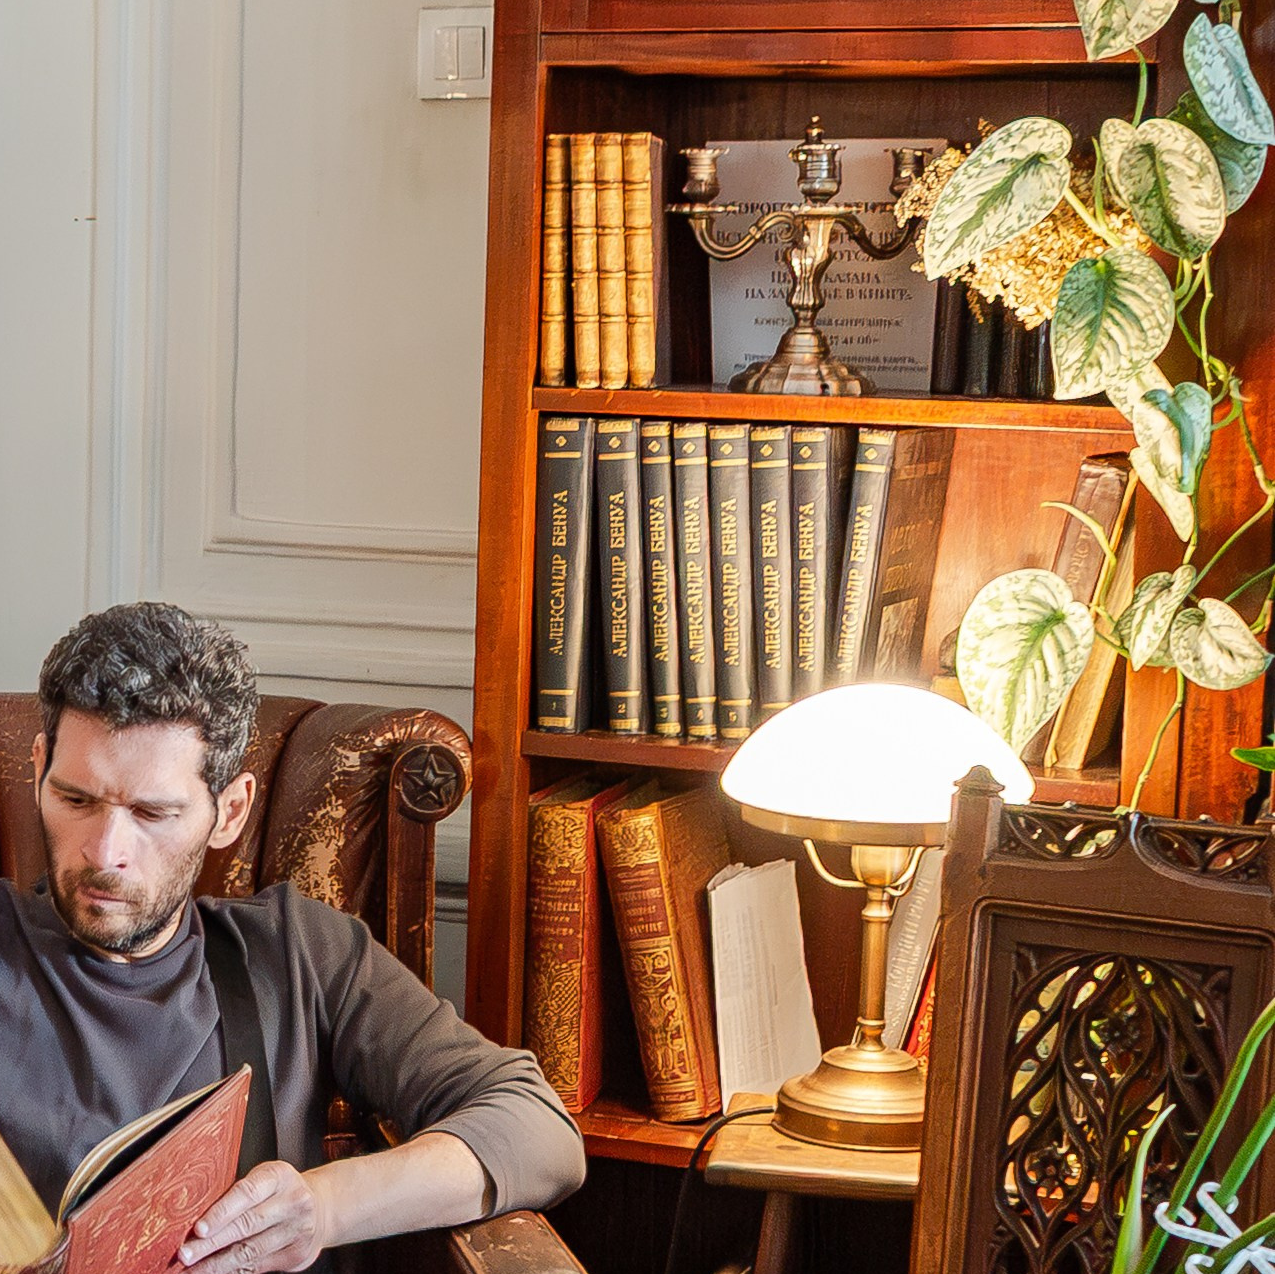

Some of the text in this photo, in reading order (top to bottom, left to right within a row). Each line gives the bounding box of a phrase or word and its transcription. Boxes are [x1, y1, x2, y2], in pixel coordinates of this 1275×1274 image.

[549, 490, 569, 656] АЛЕКСАНДР БЕНУА
[609, 491, 628, 658] АЛЕКСАНДР БЕНУА
[649, 494, 669, 662] АЛЕКСАНДР БЕНУА
[684, 496, 706, 664] АЛЕКСАНДР БЕНУА
[720, 497, 741, 666] АЛЕКСАНДР БЕНУА
[760, 499, 782, 669] АЛЕКСАНДР БЕНУА
[798, 501, 817, 672] АЛЕКСАНДР БЕНУА
[836, 504, 874, 674] АЛЕКСАНДР БЕНУА
